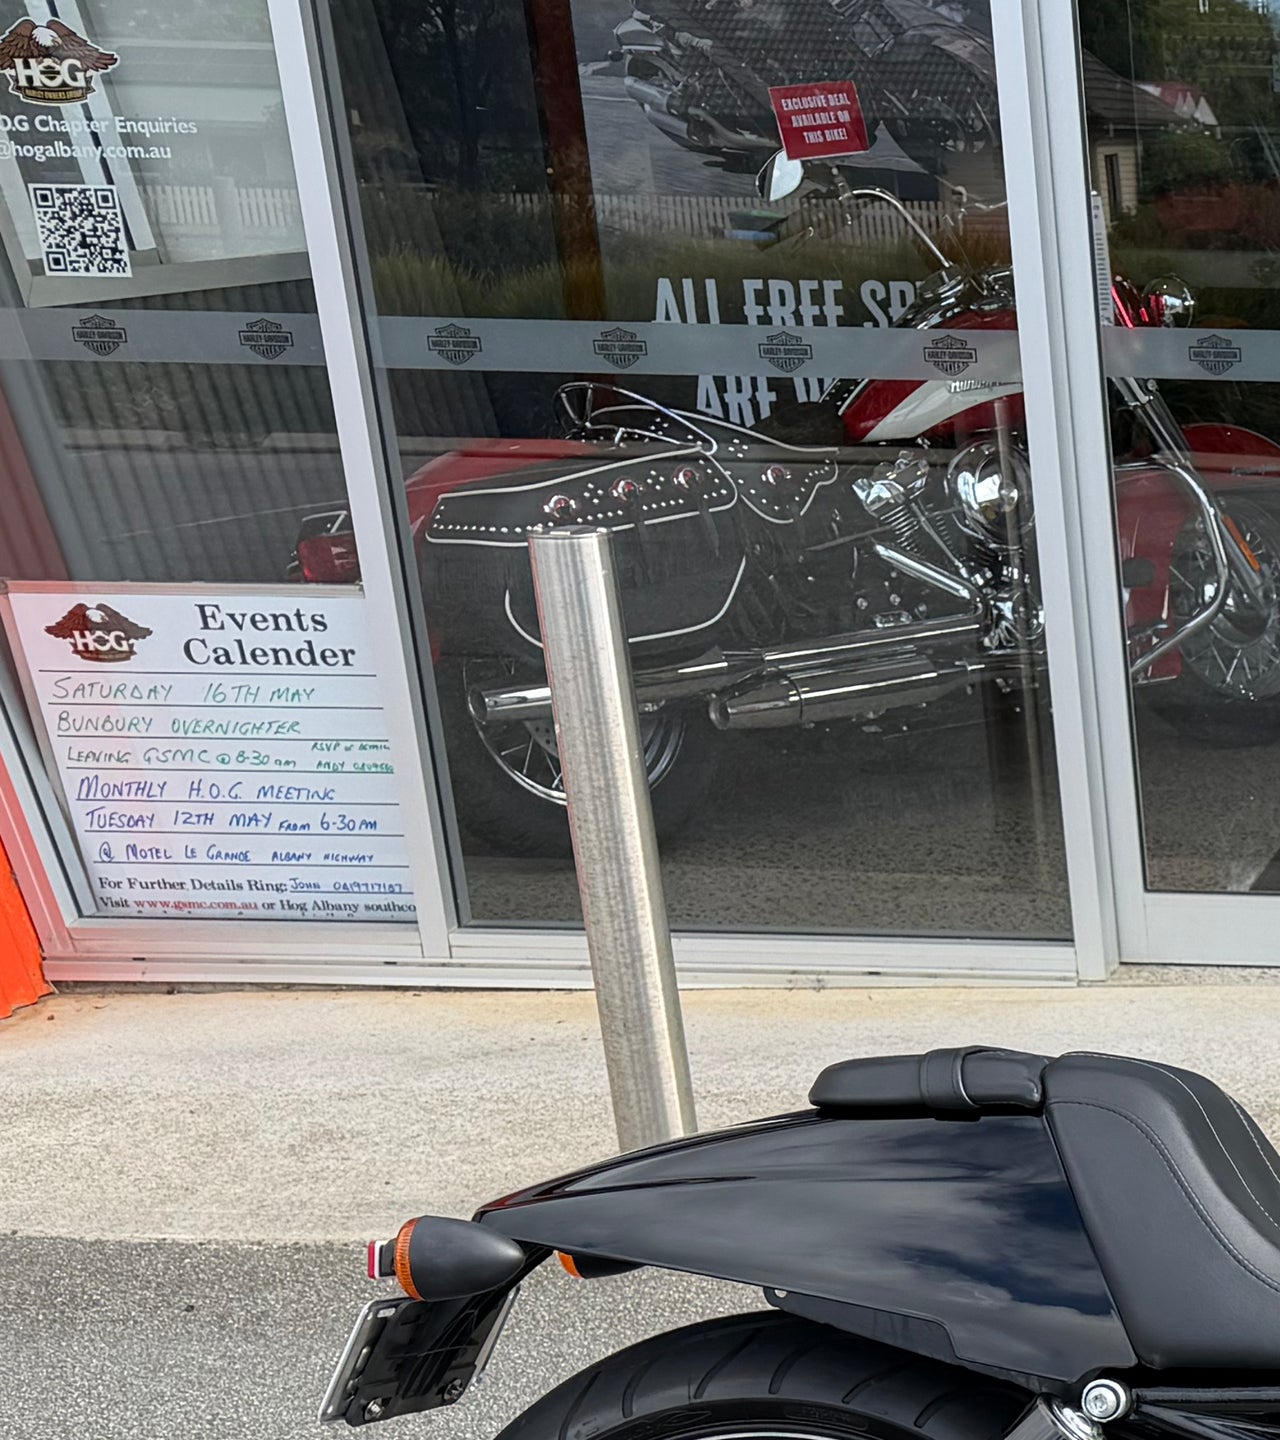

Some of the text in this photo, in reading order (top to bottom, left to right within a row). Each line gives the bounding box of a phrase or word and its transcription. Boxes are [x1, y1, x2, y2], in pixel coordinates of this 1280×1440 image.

[13, 57, 86, 88] HOG
[781, 92, 851, 111] EXCLUSIVE DEAL
[34, 115, 109, 138] Chapter
[115, 116, 198, 138] Enquiries
[791, 111, 837, 128] AVAILABLE
[802, 128, 848, 144] THIS BIKE!
[194, 602, 329, 633] Events
[74, 630, 130, 652] HOG
[183, 637, 357, 668] Calender
[52, 676, 316, 704] SATURDAY 16TH MAY
[57, 710, 302, 735] BUNBURY OVERNIGHTER
[67, 745, 131, 764] LEAVING
[143, 746, 211, 765] GSMC
[76, 774, 168, 800] MONTHLY
[256, 786, 336, 802] MEETING
[85, 805, 155, 830] TUESDAY
[173, 811, 215, 826] 12TH
[229, 811, 273, 830] MAY
[126, 843, 173, 861] MOTEL
[184, 844, 199, 860] LE
[205, 845, 252, 862] GRANDE
[270, 851, 312, 862] ALBANY
[322, 851, 375, 863] HIGHWAY
[98, 876, 288, 895] For Further Details Ring:
[99, 896, 130, 909] Visit
[261, 901, 277, 911] or
[280, 900, 308, 914] Hog
[311, 901, 359, 914] Albany
